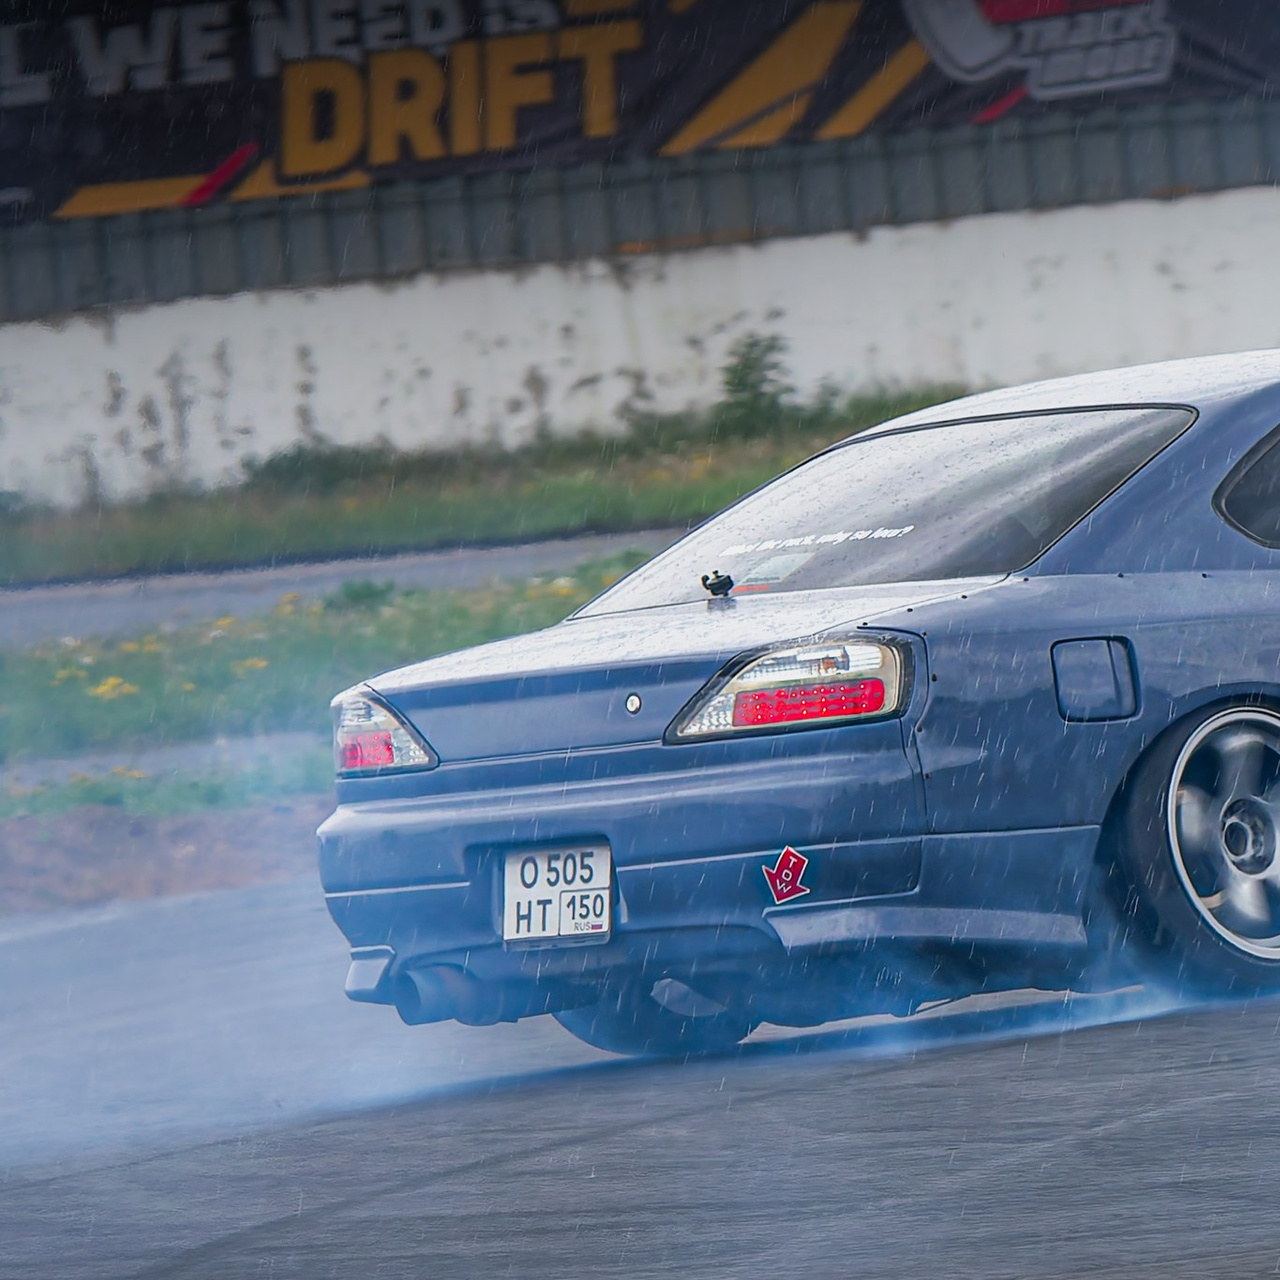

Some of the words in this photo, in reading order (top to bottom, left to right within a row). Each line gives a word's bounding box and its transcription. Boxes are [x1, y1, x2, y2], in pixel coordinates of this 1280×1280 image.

[66, 1, 235, 97] WE
[280, 18, 643, 177] DRIFT
[546, 851, 594, 887] 505
[776, 855, 798, 893] TOW
[515, 898, 553, 934] HT
[566, 893, 604, 921] 150
[574, 921, 591, 932] RUS
